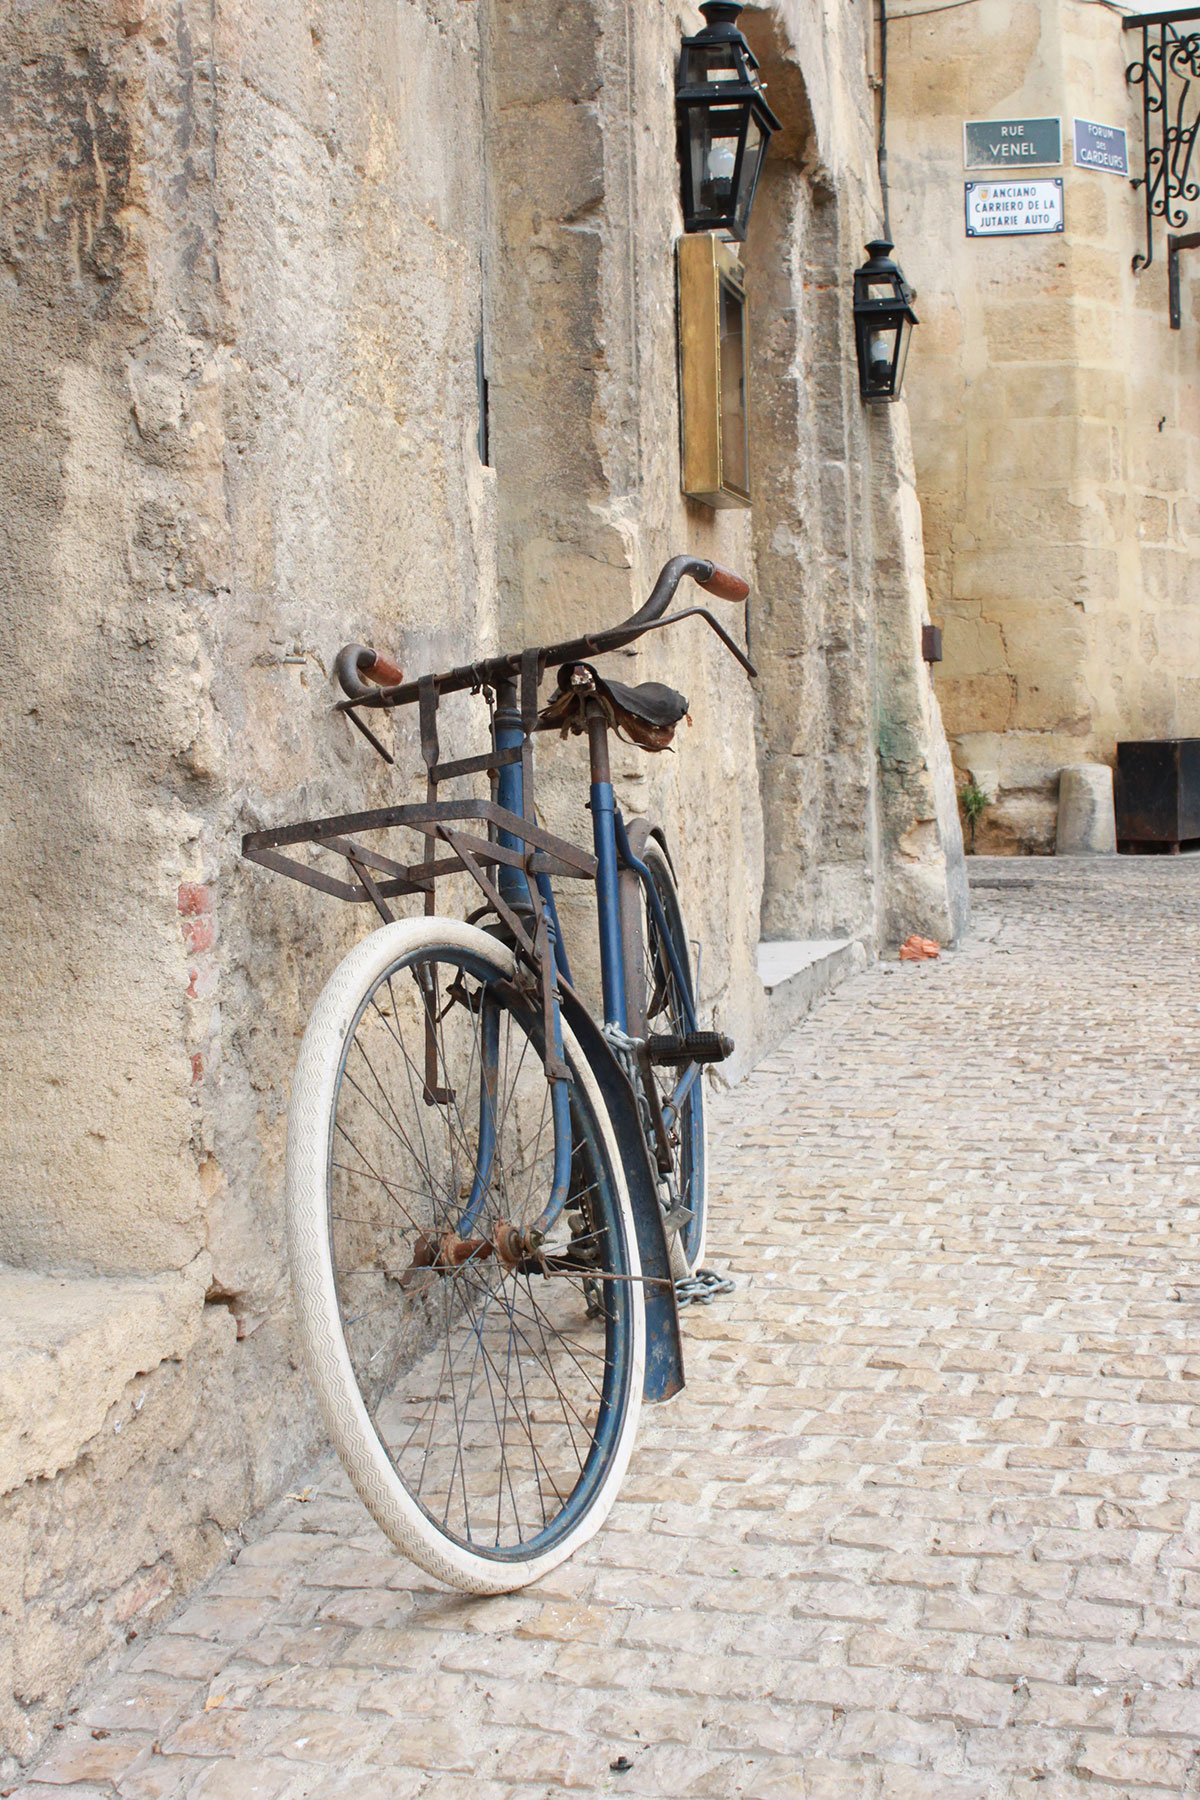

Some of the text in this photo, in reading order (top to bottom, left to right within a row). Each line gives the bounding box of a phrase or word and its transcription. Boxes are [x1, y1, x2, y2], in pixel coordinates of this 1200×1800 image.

[1001, 125, 1025, 137] RUE
[1088, 124, 1113, 139] FORUM
[989, 142, 1037, 157] VENEL
[1080, 148, 1124, 168] CARDEURS
[992, 187, 1037, 199] ANCIANO
[975, 199, 1055, 213] CARRIERO DE LA
[980, 214, 1050, 227] JUTARIE AUTO
